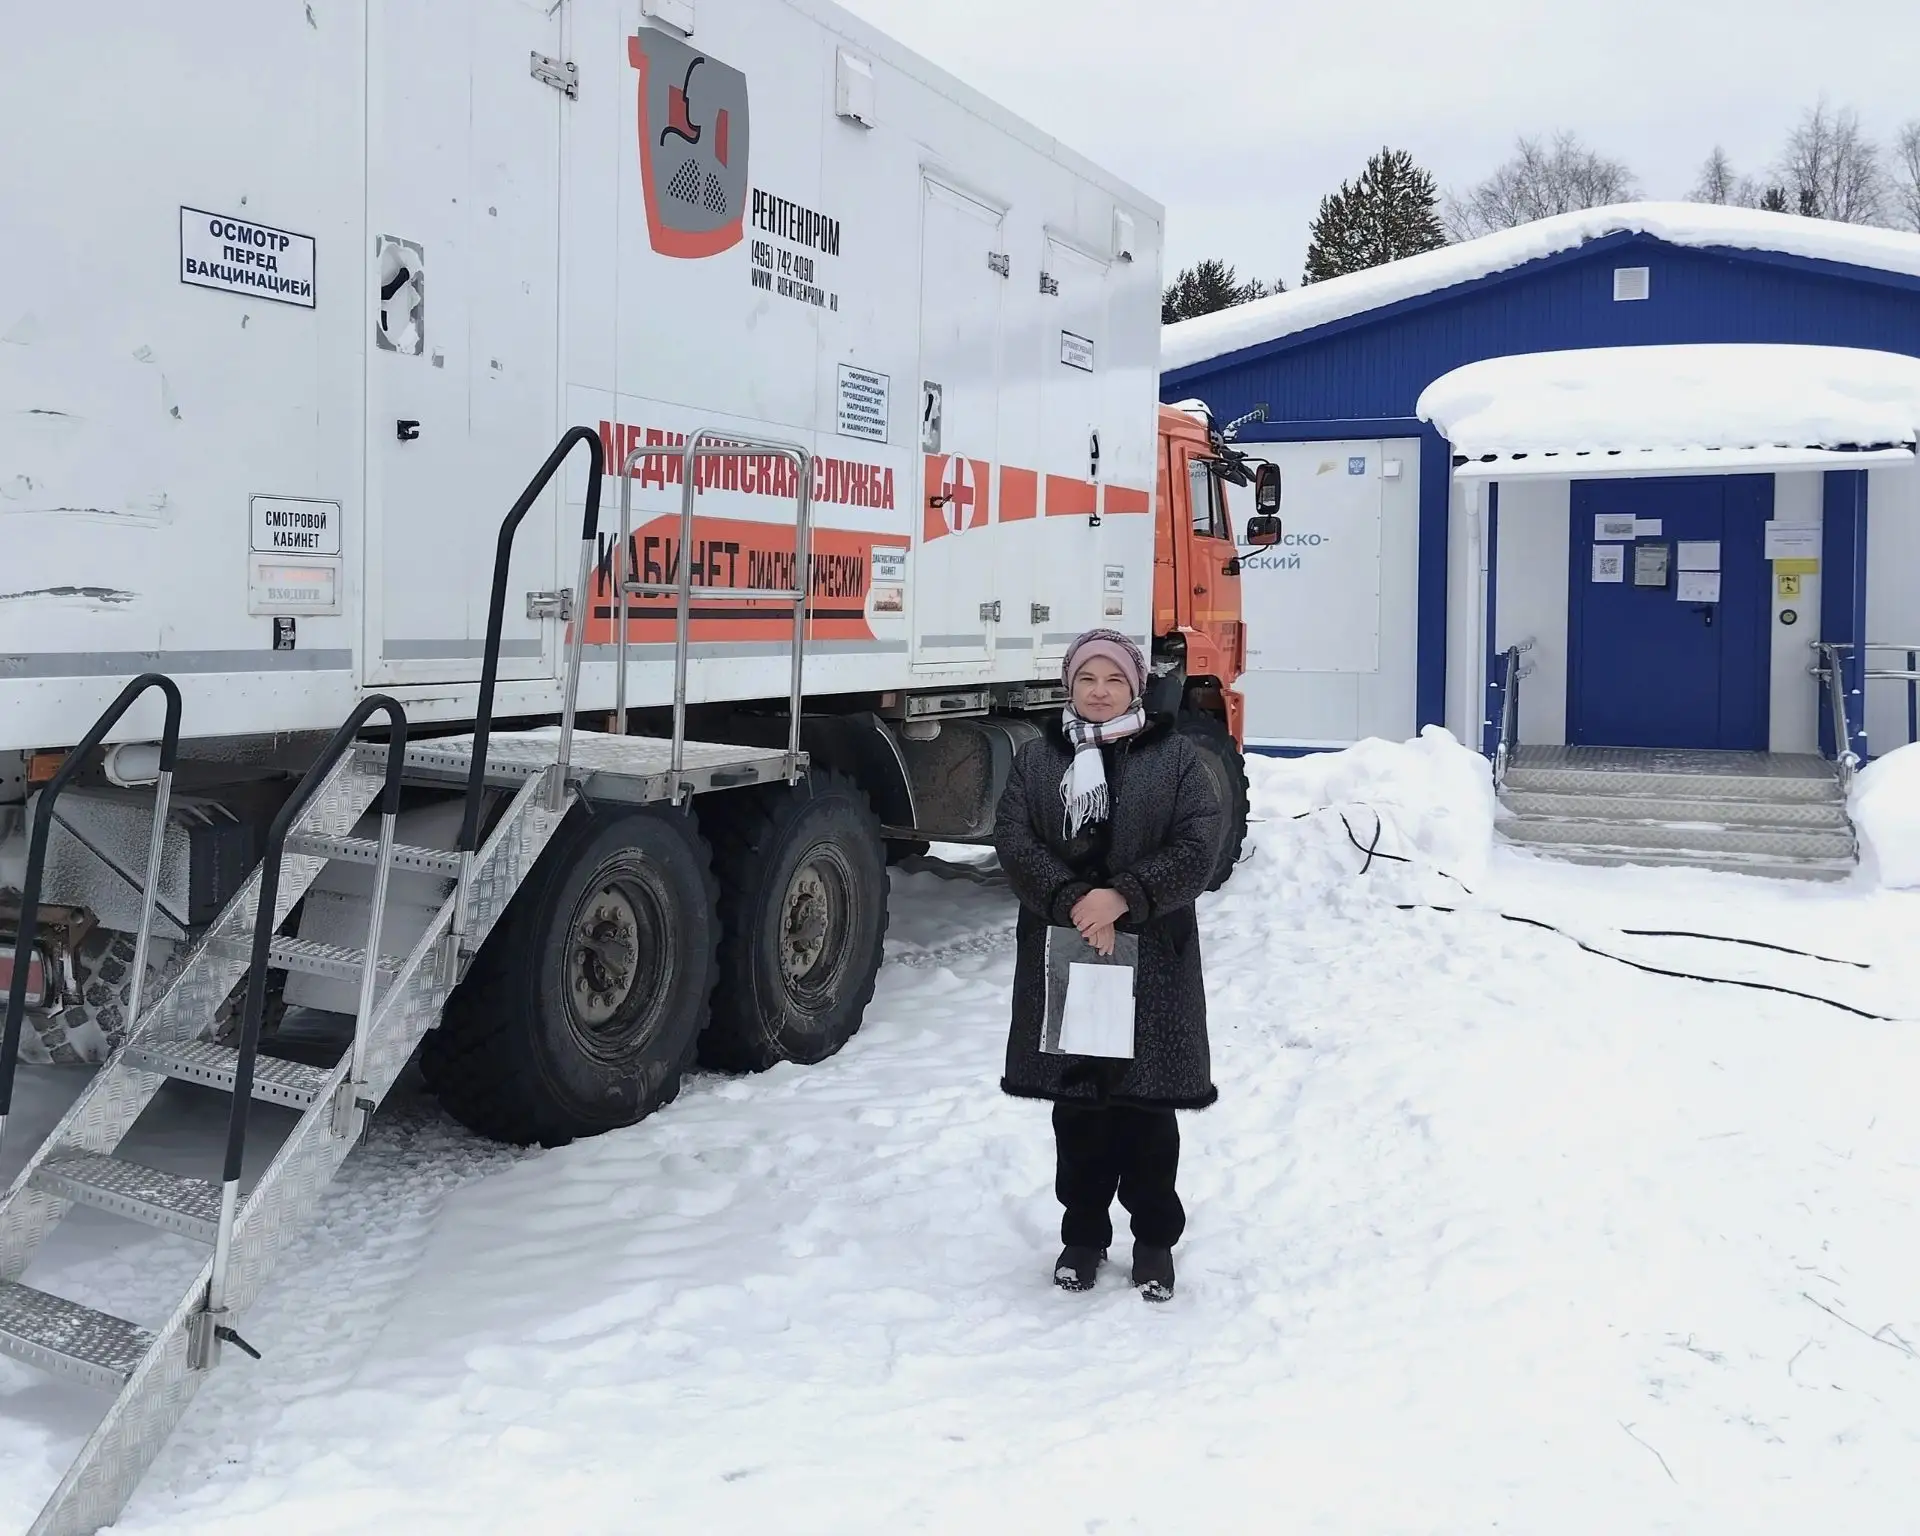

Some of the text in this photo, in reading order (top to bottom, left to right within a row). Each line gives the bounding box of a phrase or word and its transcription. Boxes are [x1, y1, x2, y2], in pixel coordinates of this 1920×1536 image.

[209, 219, 290, 252] ОСМОТР
[752, 187, 840, 257] РЕНТГЕНПРОМ
[223, 245, 278, 273] ПЕРЕД
[751, 239, 814, 284] (495) 742 4090
[185, 257, 311, 297] ВАКЦИНАЦИЕЙ
[849, 372, 878, 384] ОФОРМЛЕНИЕ
[843, 391, 873, 403] ПРОВЕДЕНИЕ
[846, 402, 879, 415] НАПРАВЛЕНИЕ
[847, 413, 885, 426] ФЛЮОРОГРАФИЮ
[810, 455, 894, 510] СЛУЖБА
[265, 511, 327, 529] СМОТРОВОЙ
[273, 531, 320, 548] КАБИНЕТ
[746, 546, 864, 606] ДИАГНОТИЧЕСКИЙ
